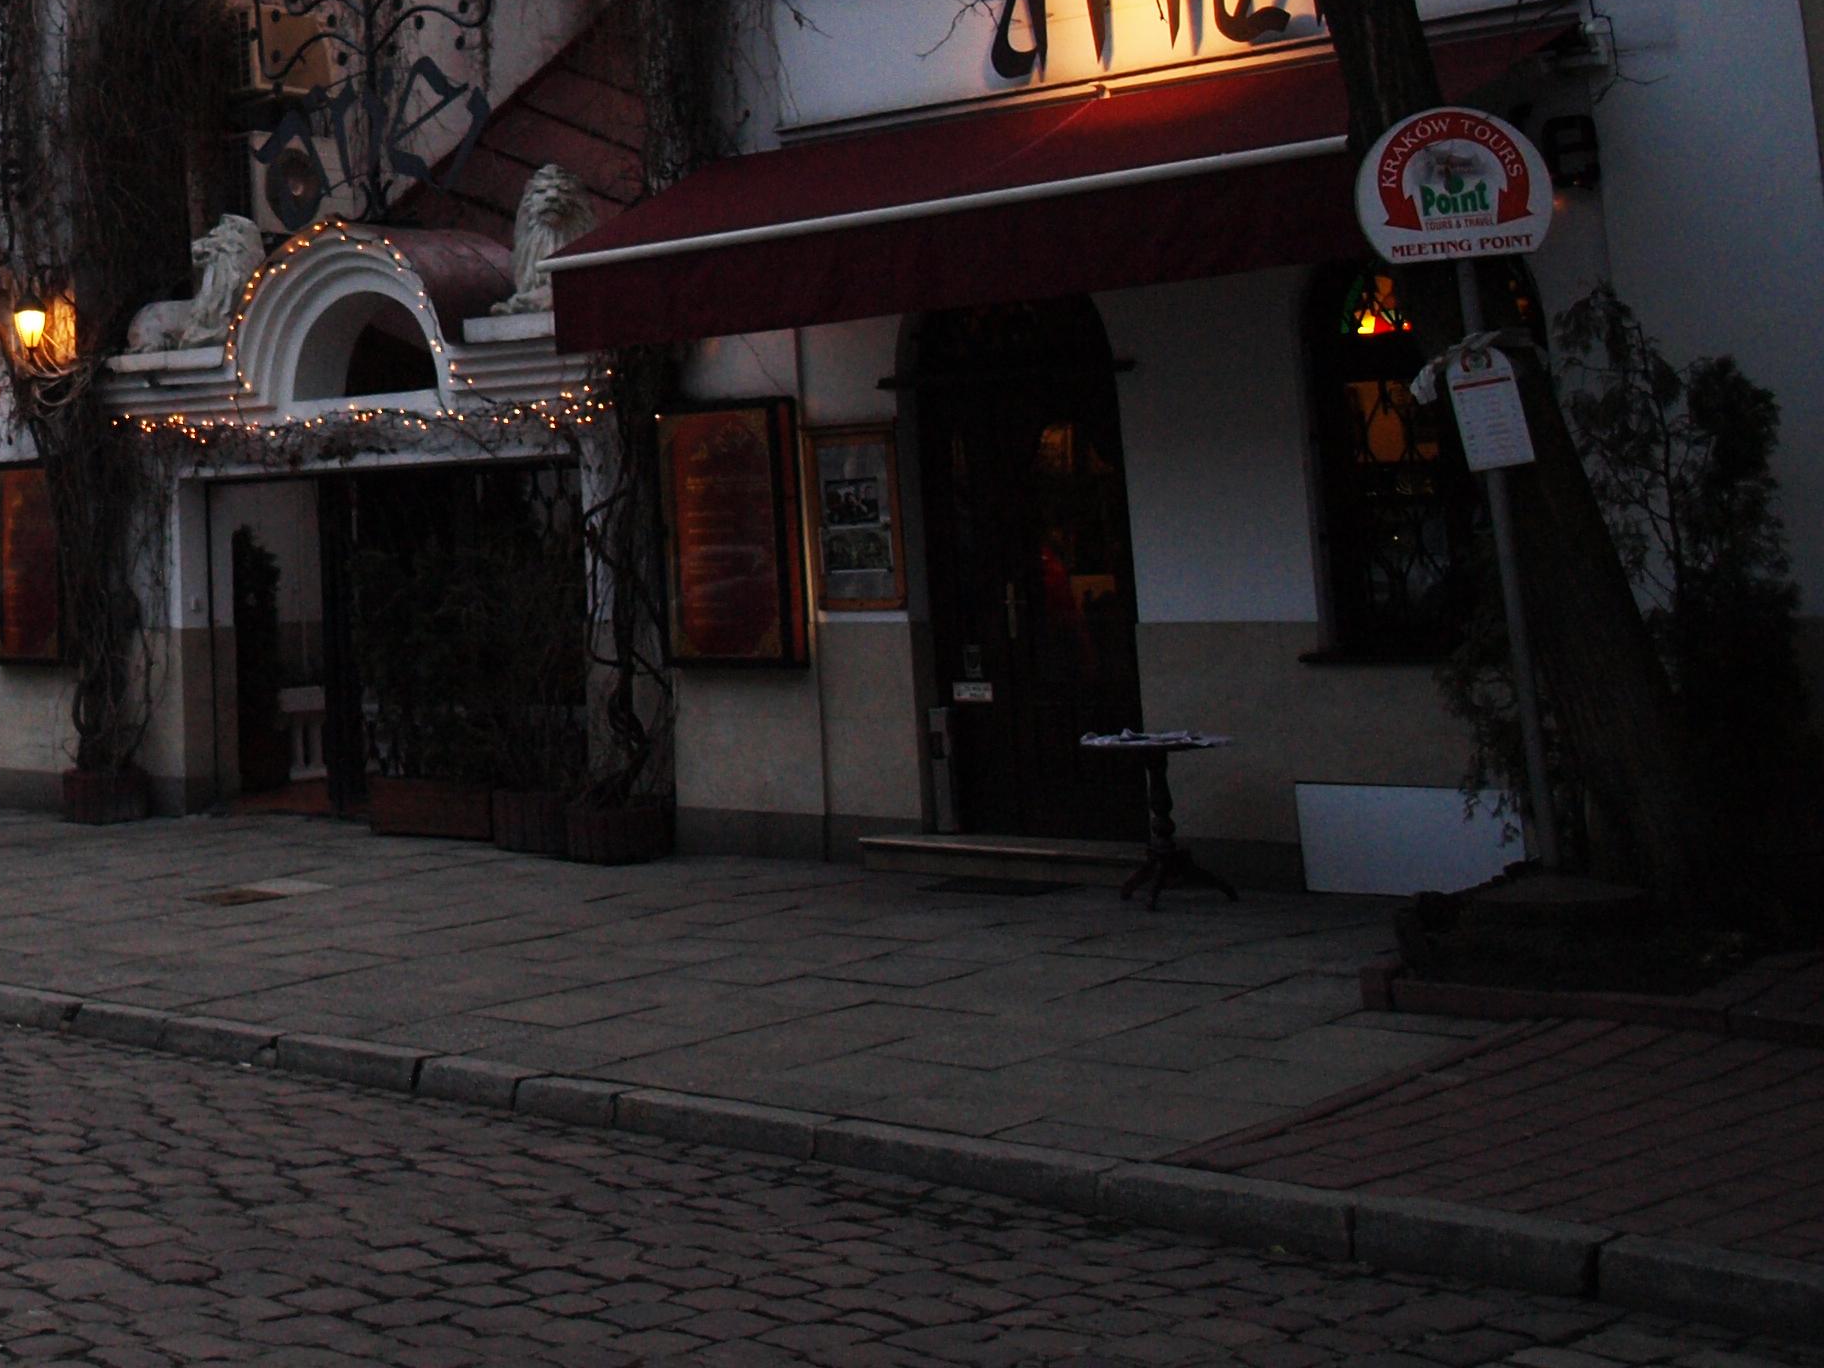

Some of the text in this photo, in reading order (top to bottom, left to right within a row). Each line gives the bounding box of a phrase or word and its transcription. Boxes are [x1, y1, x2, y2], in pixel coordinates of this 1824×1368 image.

[1382, 118, 1524, 188] KRAKÓW TOURS
[1420, 178, 1490, 217] Point
[1425, 220, 1453, 231] TOURS
[1391, 234, 1534, 258] MEETING POINT
